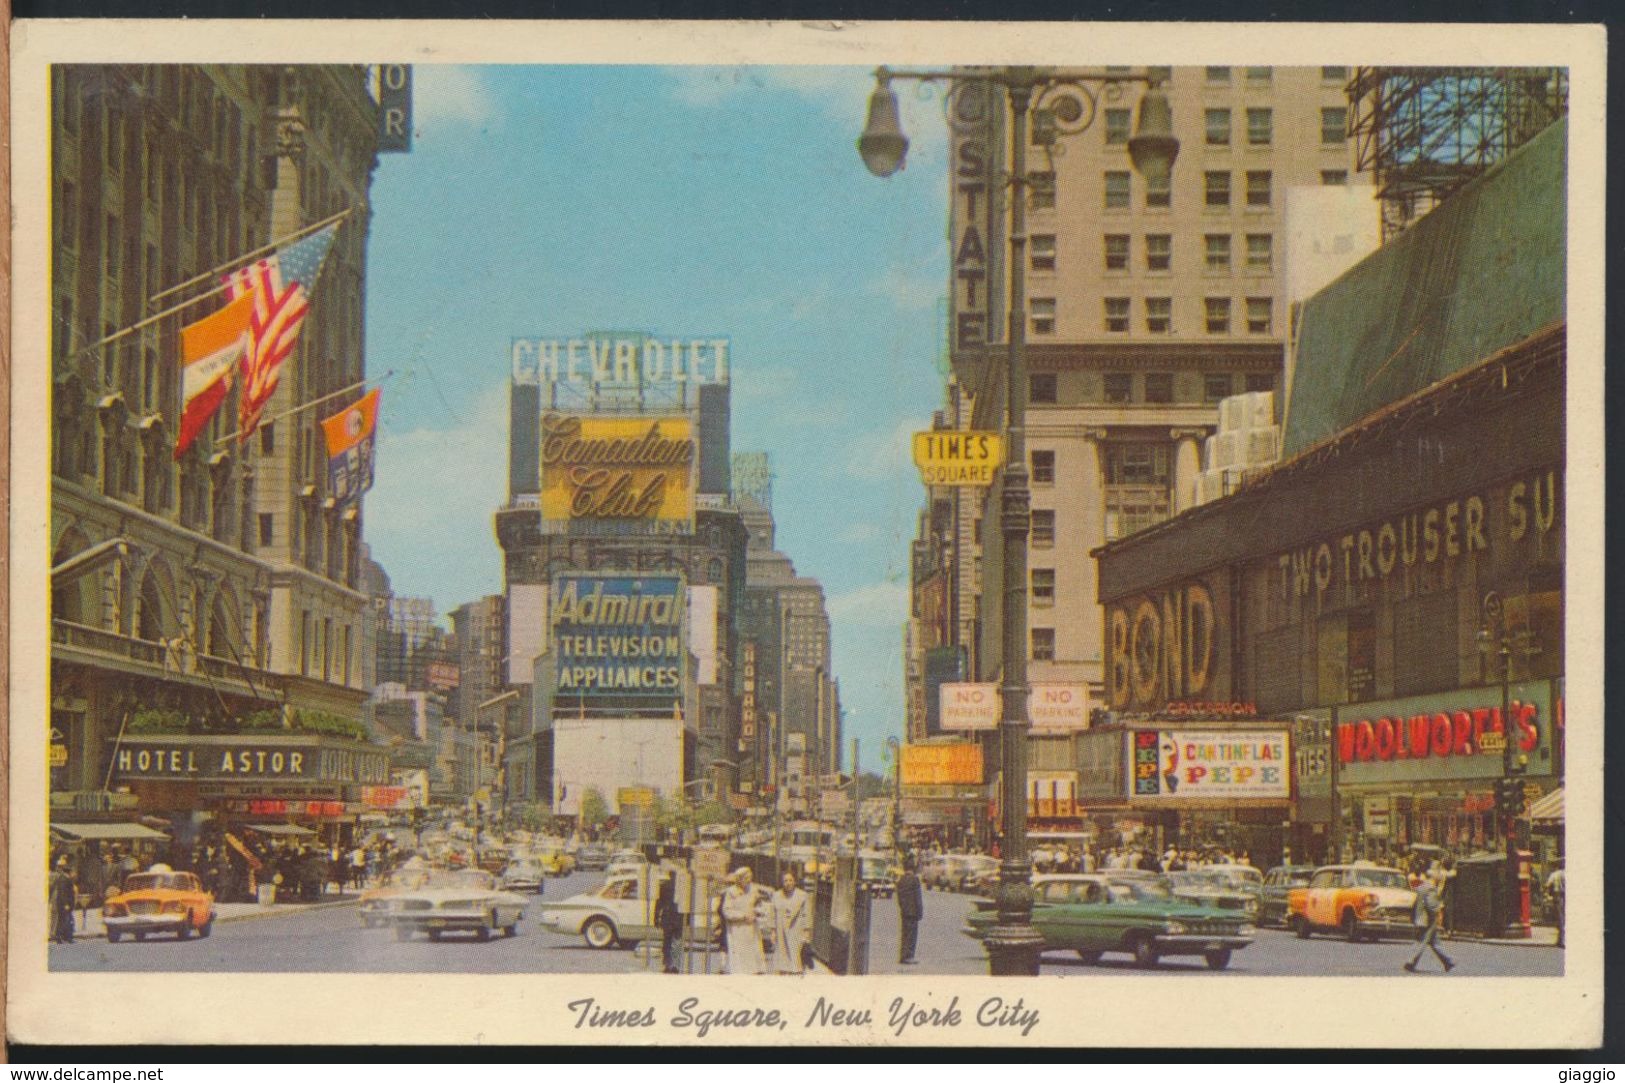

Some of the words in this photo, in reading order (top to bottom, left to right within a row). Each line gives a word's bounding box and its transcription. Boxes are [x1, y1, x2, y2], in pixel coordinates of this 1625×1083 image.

[957, 139, 985, 350] STATE
[512, 339, 729, 384] CHEVROLET
[543, 414, 695, 464] Canadian
[927, 436, 989, 459] TIMES
[926, 465, 989, 482] SQUARE
[570, 466, 666, 518] Club
[1280, 543, 1332, 600] TWO
[1341, 496, 1487, 578] TROUSER
[551, 580, 686, 625] Admiral
[561, 636, 679, 656] TELEVISION
[1112, 585, 1214, 706] BOND
[560, 666, 680, 688] APPLIANCES
[956, 690, 984, 704] NO
[1046, 690, 1072, 704] NO
[119, 751, 198, 771] HOTEL
[221, 752, 303, 773] ASTOR
[1185, 743, 1283, 761] CANTINFLAS
[1185, 766, 1281, 784] PEPE
[568, 997, 655, 1028] Times
[671, 997, 787, 1037] Square,
[805, 996, 872, 1027] New
[889, 997, 961, 1036] York
[977, 996, 1039, 1036] City
